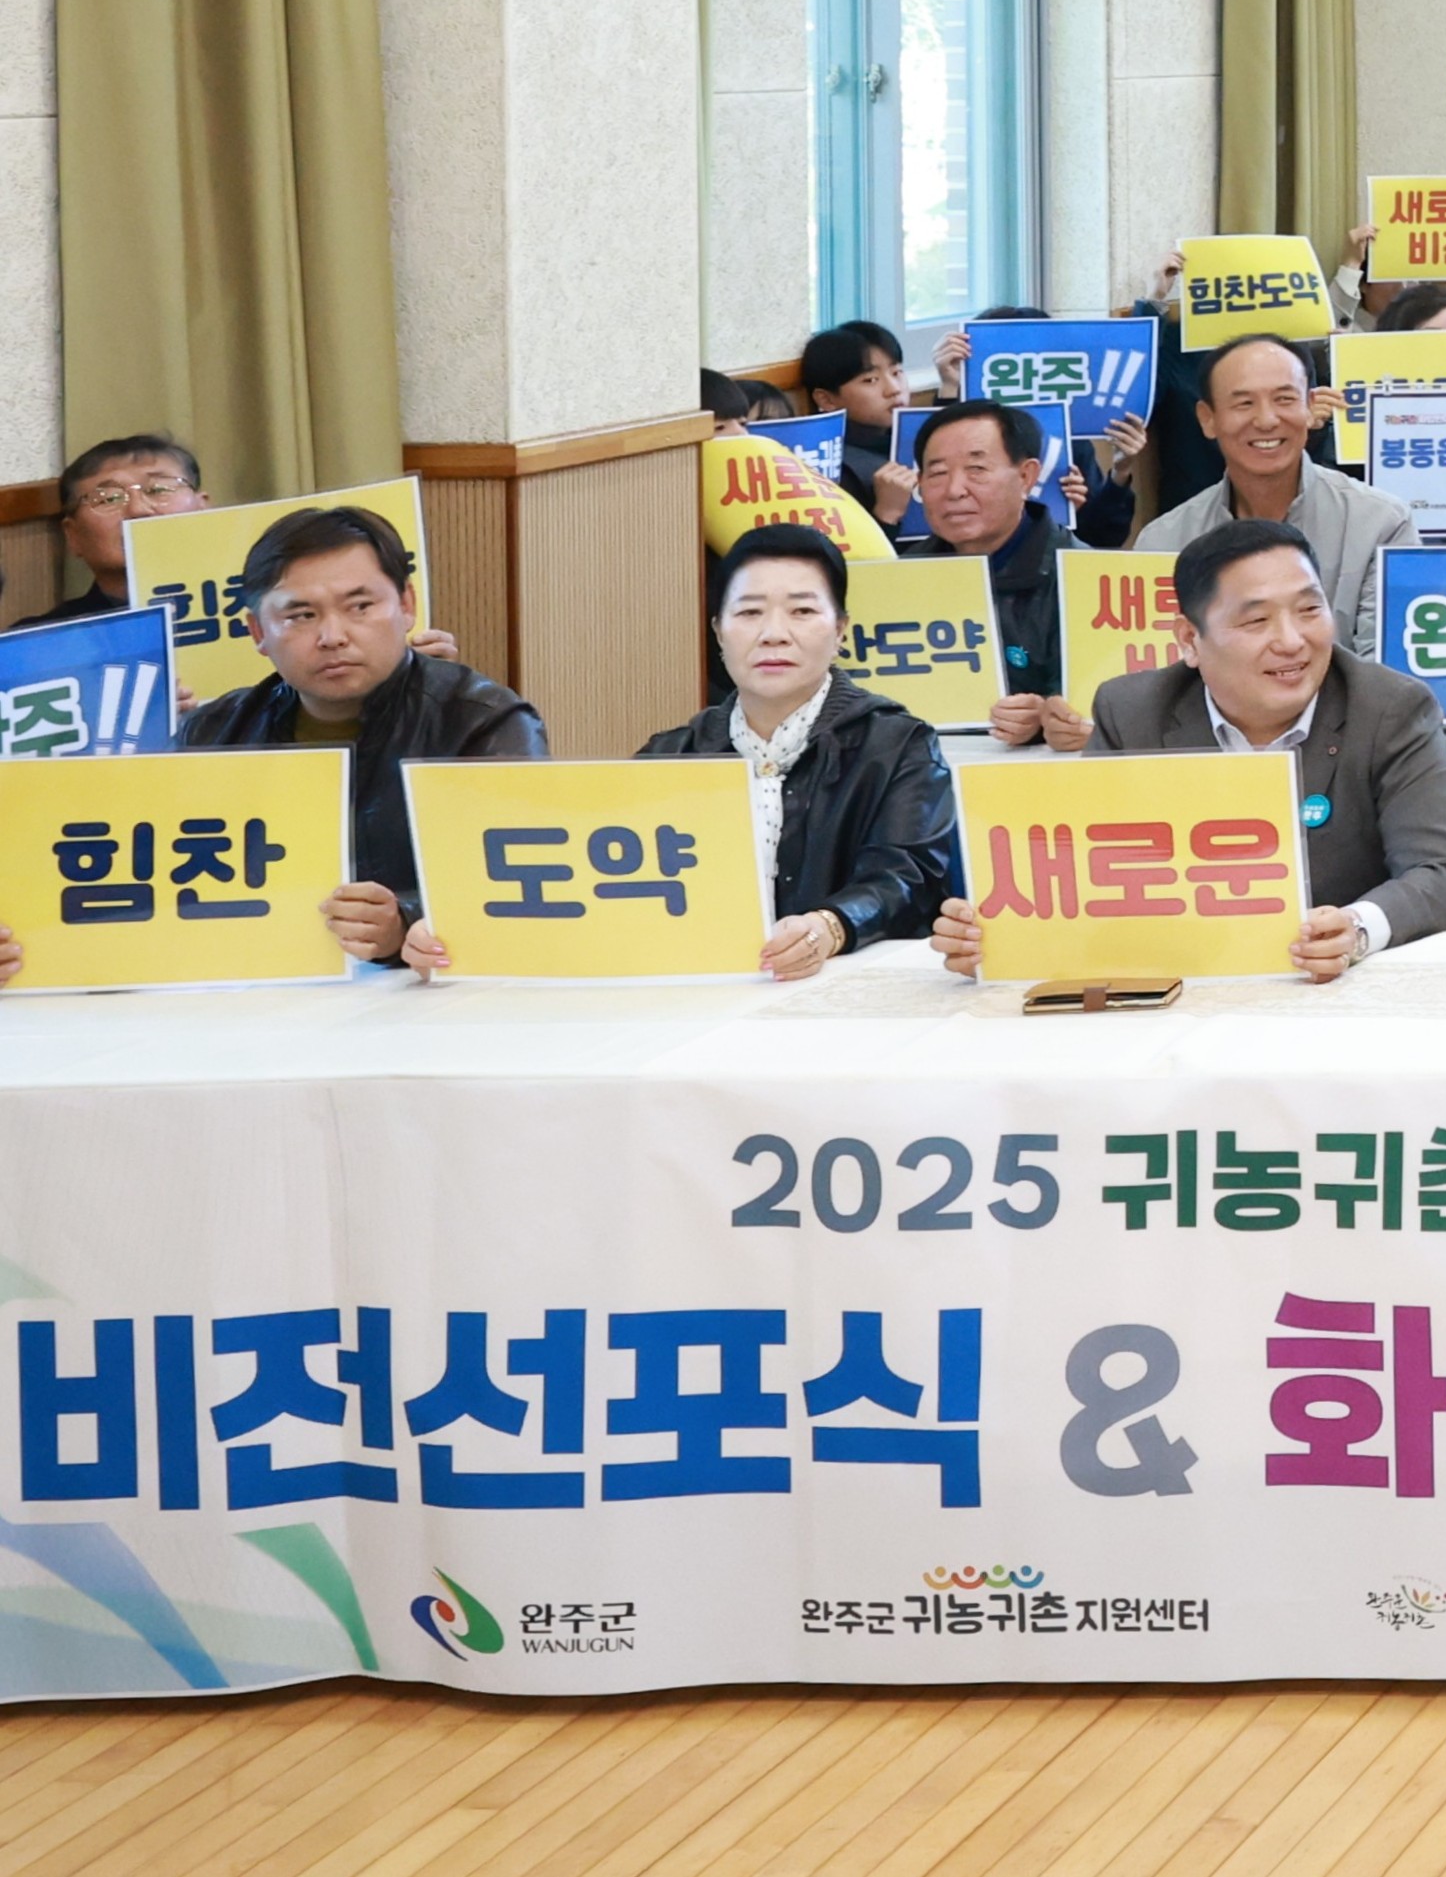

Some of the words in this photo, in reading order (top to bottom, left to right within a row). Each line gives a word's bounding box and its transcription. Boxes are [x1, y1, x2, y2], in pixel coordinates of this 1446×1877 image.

[1187, 271, 1321, 317] 힘찬도약
[986, 349, 1146, 409] 완주!!
[51, 816, 287, 926] 힘찬
[482, 824, 698, 919] 도약
[978, 817, 1290, 921] 새로운
[730, 1131, 1062, 1233] 2025
[16, 1302, 984, 1512] 비전선포식
[1058, 1322, 1200, 1497] &
[518, 1601, 638, 1636] 완주군
[520, 1636, 635, 1655] WANJUGUN
[800, 1597, 896, 1635] 완주군
[901, 1591, 1070, 1635] 귀농귀촌
[1074, 1596, 1210, 1632] 지원센터
